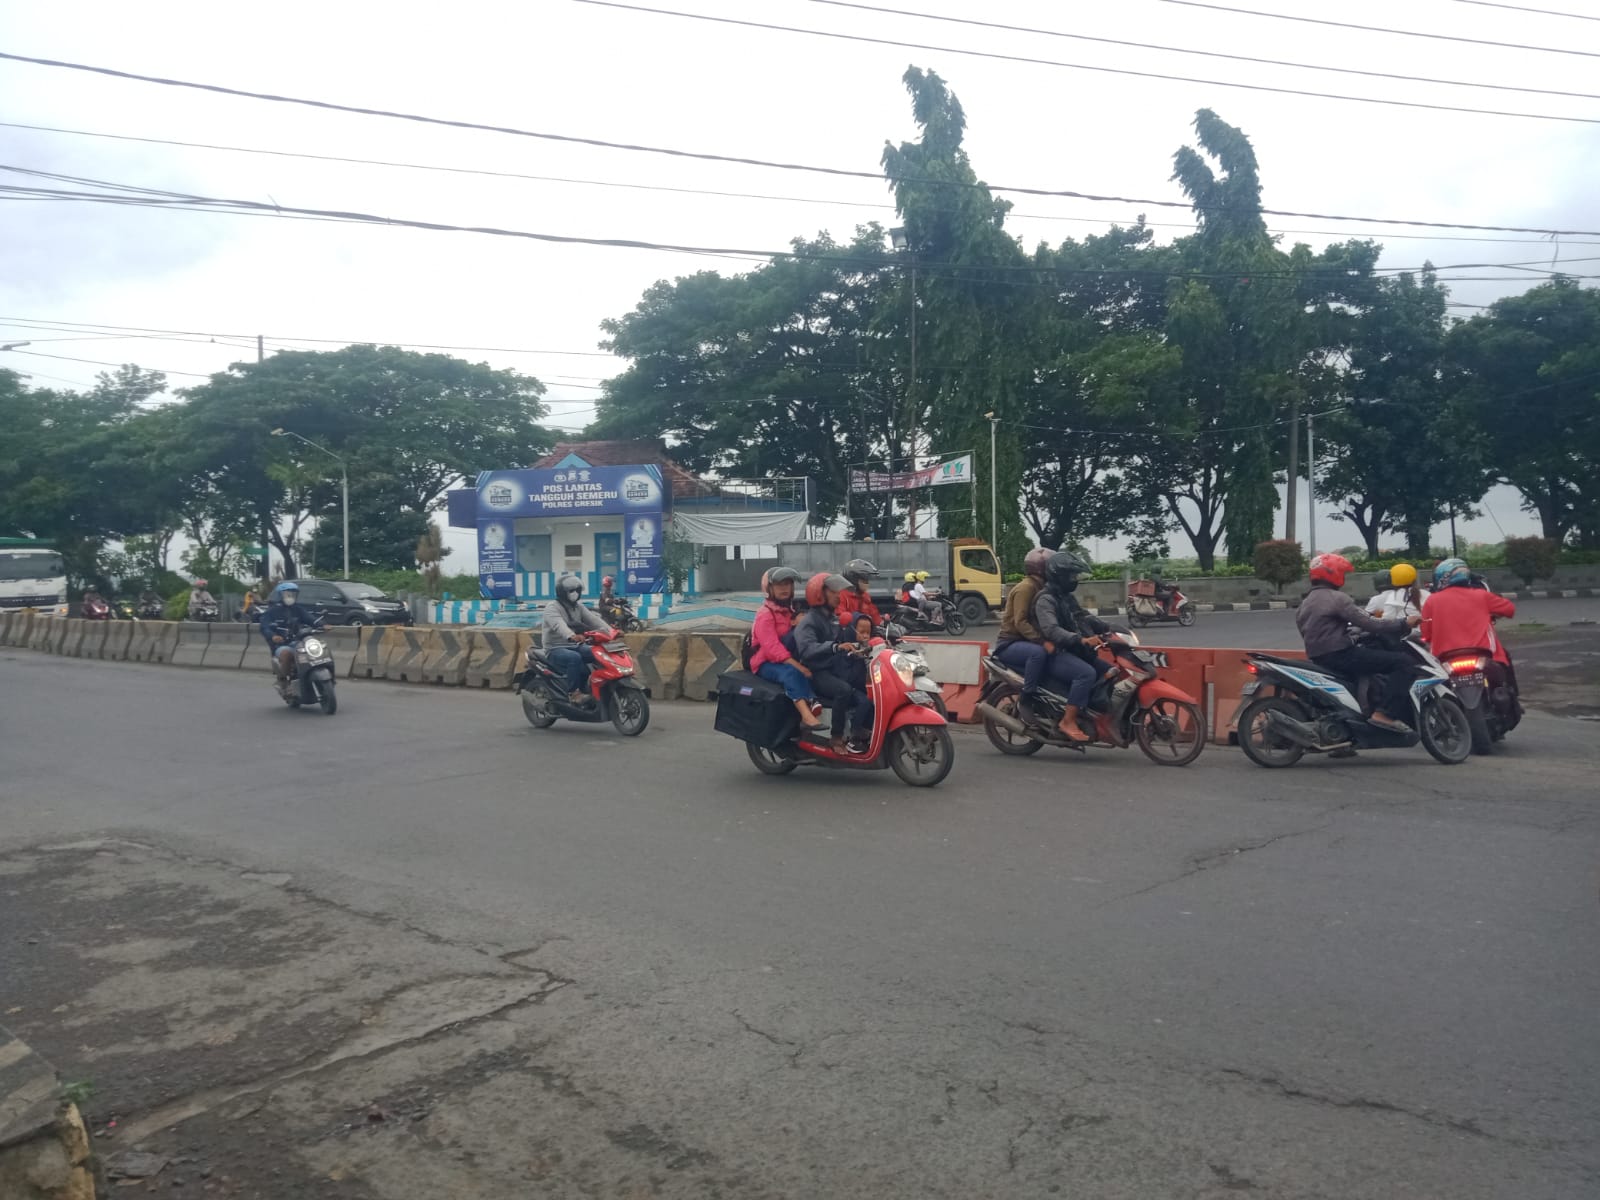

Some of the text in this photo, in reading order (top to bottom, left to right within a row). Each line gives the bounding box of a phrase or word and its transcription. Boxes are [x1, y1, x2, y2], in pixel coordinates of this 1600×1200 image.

[543, 483, 602, 493] POS LANTAS
[528, 491, 618, 502] TANGGUH SEMERU
[542, 501, 573, 509] POLRES
